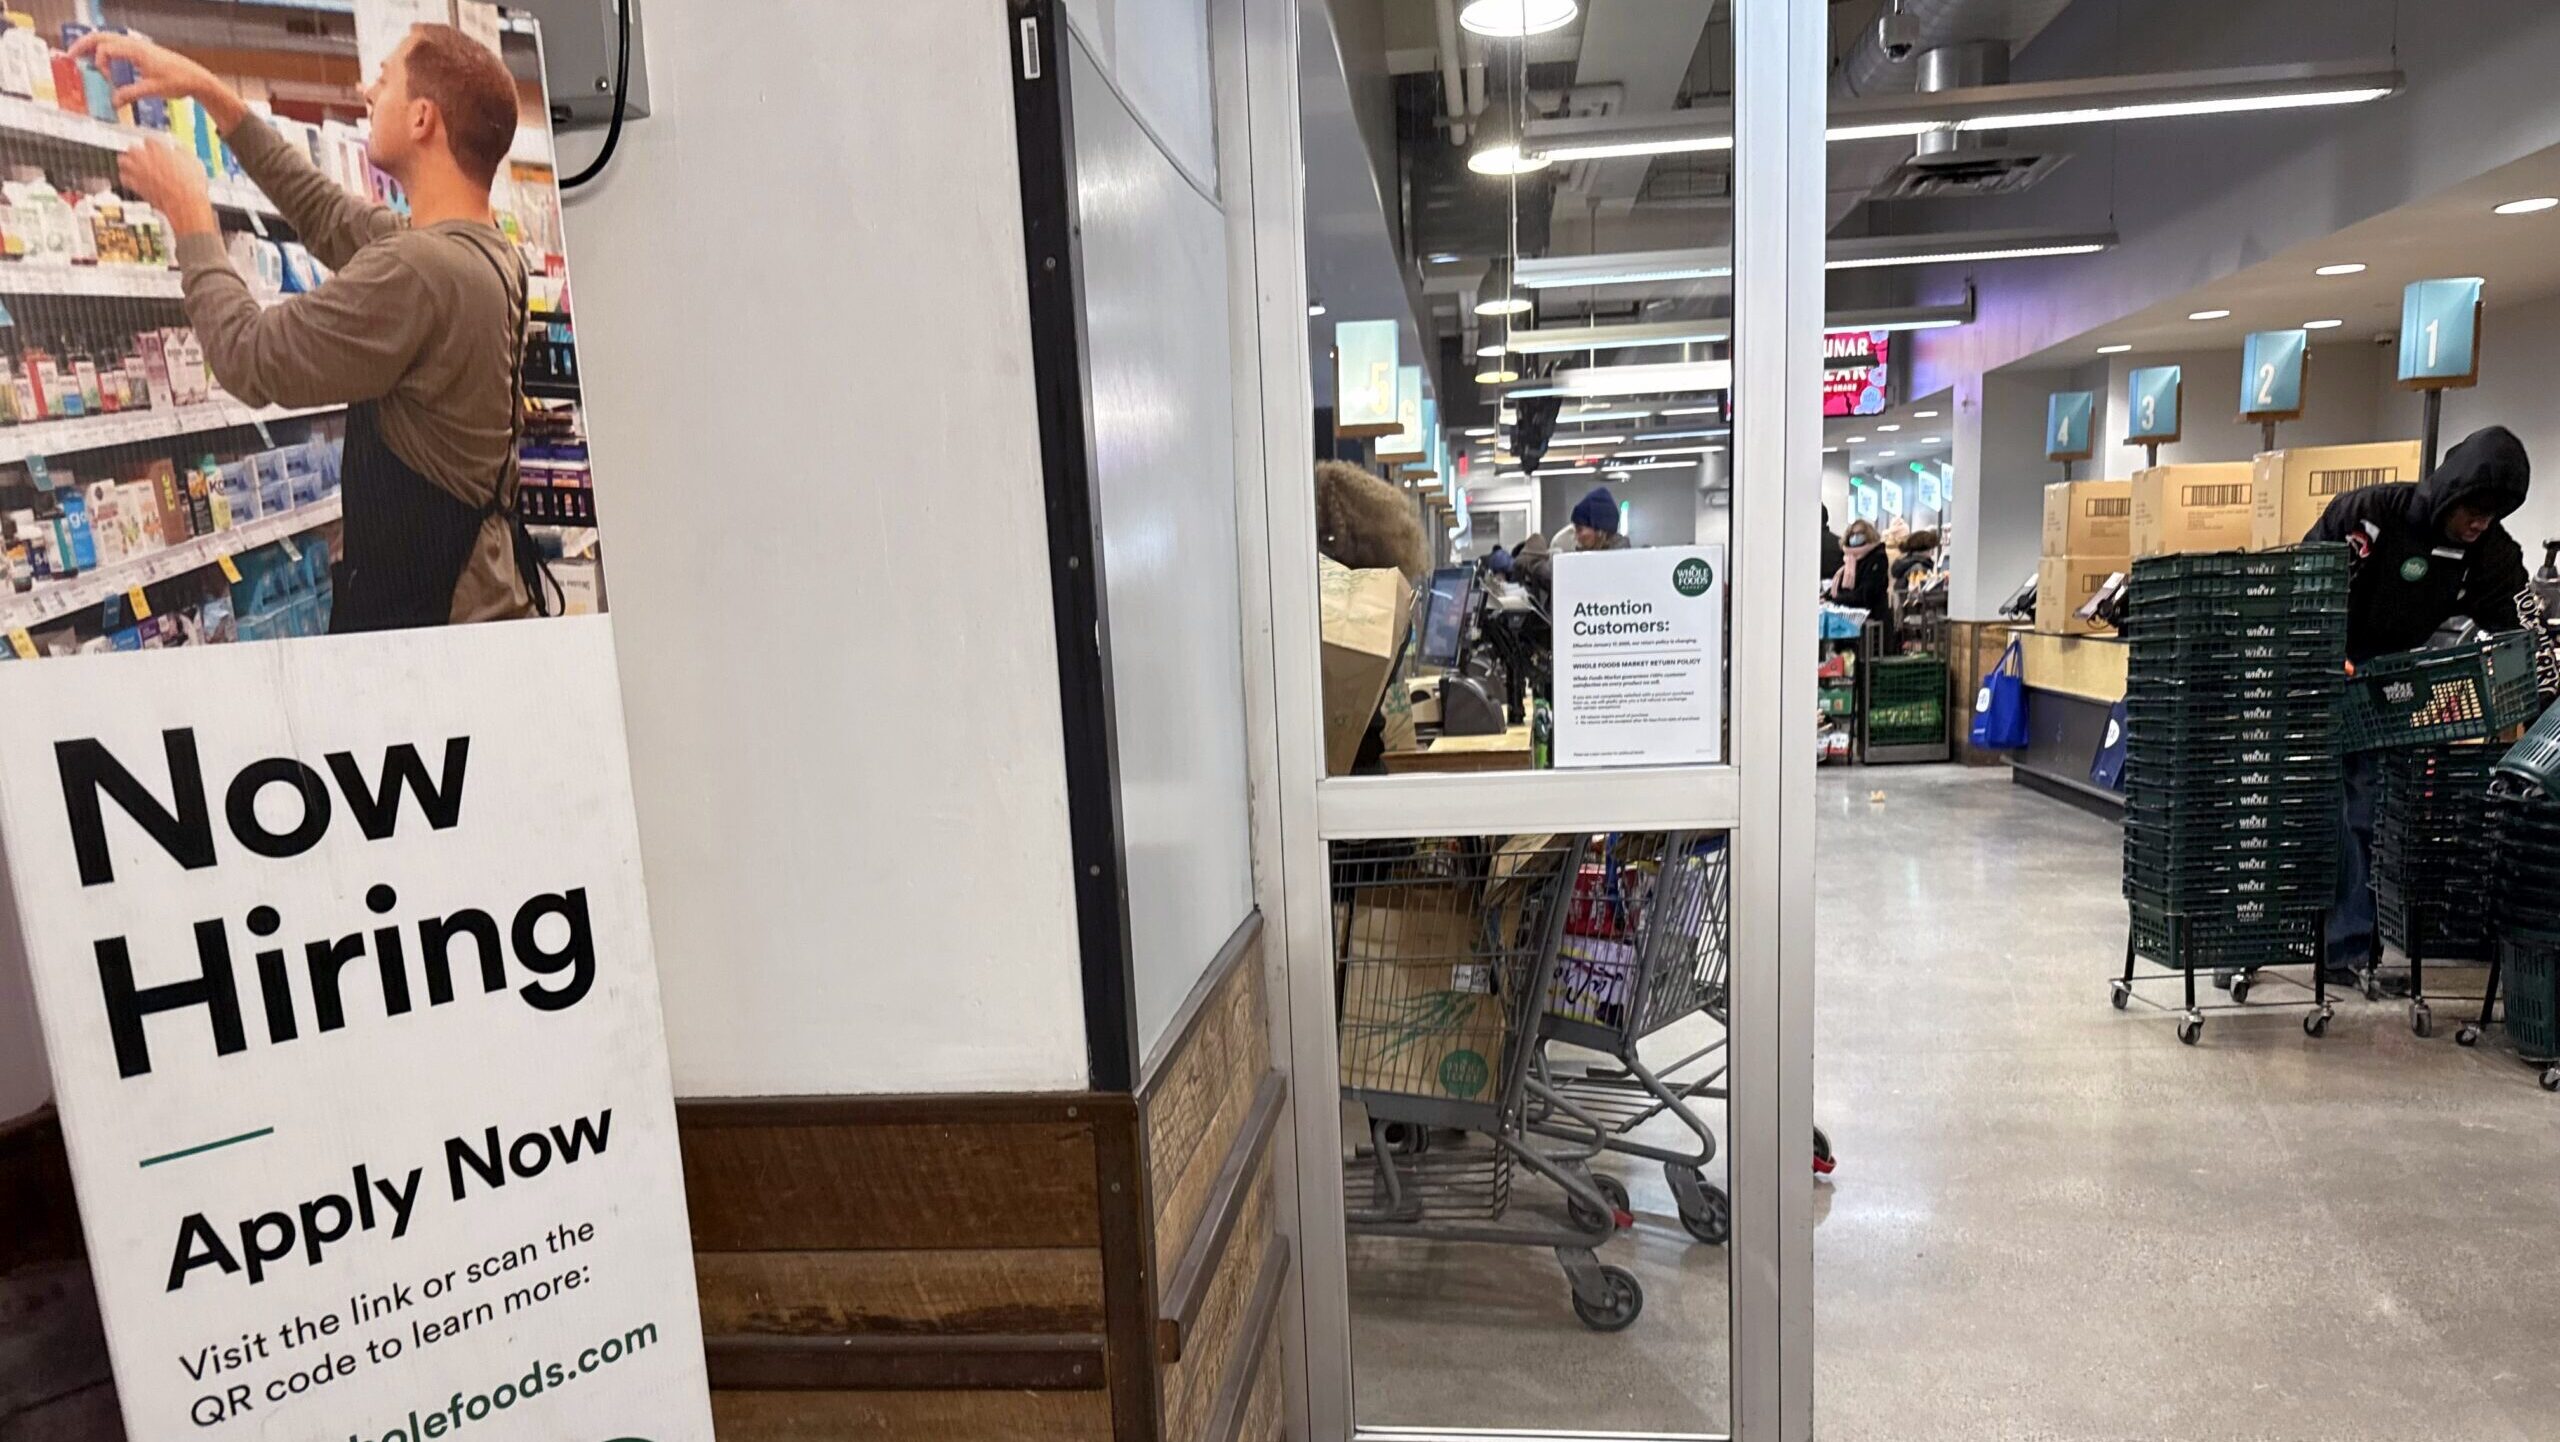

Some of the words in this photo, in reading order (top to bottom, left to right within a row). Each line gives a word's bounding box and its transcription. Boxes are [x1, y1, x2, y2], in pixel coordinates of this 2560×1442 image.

[2426, 320, 2439, 368] 1
[1369, 361, 1389, 416] 5
[2257, 363, 2274, 404] 2
[2142, 395, 2155, 431] 3
[2057, 415, 2069, 446] 4
[1677, 566, 1709, 578] WHOLE
[1678, 577, 1709, 586] FOODS
[1573, 600, 1652, 618] Attention
[1573, 620, 1670, 637] Customers:
[1621, 660, 1649, 668] MARKET
[1650, 659, 1675, 667] RETURN
[2242, 751, 2271, 763] WHOLE
[2241, 773, 2270, 785] WHOLE
[54, 727, 470, 887] Now
[2240, 794, 2269, 806] WHOLE
[2238, 858, 2267, 870] WHOLE
[2237, 880, 2266, 892] WHOLE
[94, 884, 597, 1079] Hiring
[166, 1163, 423, 1293] Apply
[444, 1108, 612, 1202] Now
[179, 1331, 269, 1382] Visit
[279, 1312, 341, 1351] the
[351, 1281, 415, 1325] link
[423, 1268, 457, 1299] or
[465, 1243, 538, 1284] scan
[545, 1218, 596, 1254] the
[190, 1384, 254, 1427] QR
[265, 1353, 357, 1401] code
[366, 1334, 402, 1365] to
[411, 1303, 494, 1349] learn
[503, 1263, 592, 1315] more:
[349, 1321, 659, 1442] lefoods.com
